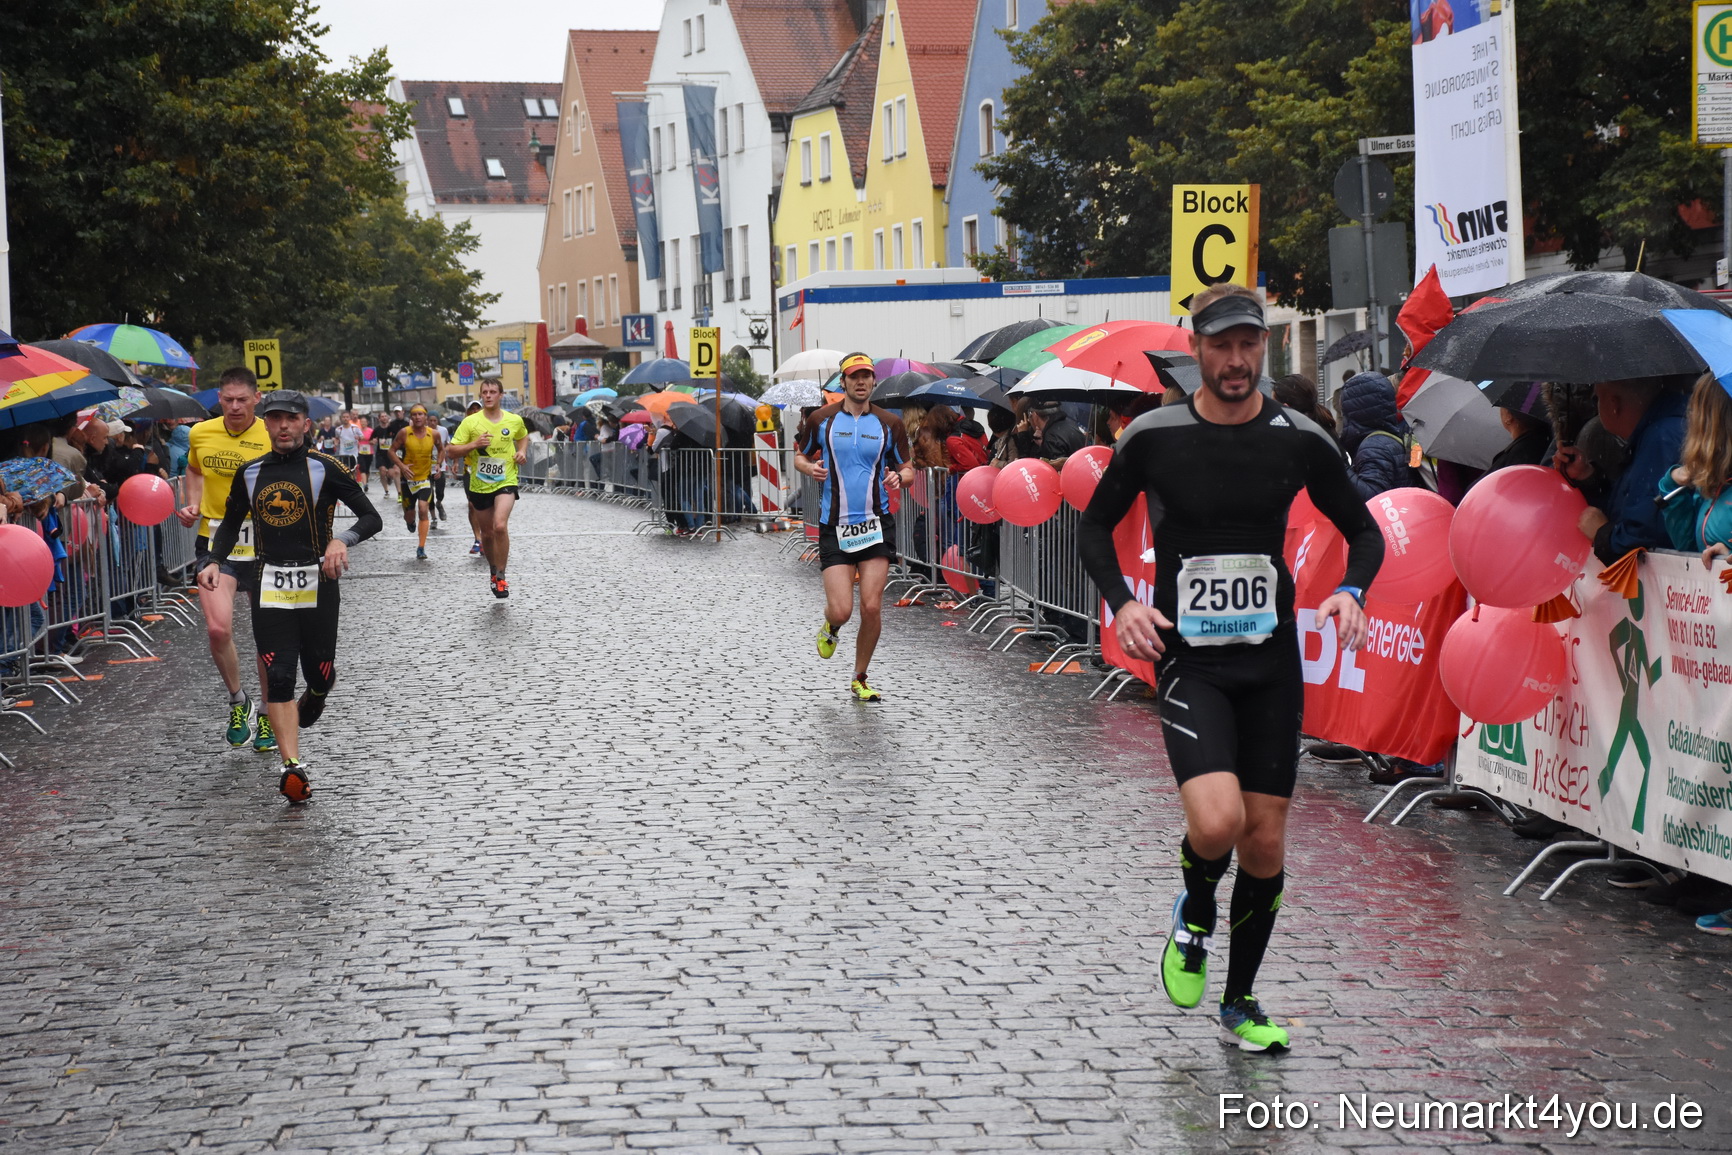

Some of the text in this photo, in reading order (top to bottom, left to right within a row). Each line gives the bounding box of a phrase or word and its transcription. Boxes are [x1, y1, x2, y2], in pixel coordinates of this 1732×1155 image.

[1371, 138, 1416, 151] Ulmer Gass
[1182, 190, 1249, 214] Block
[813, 208, 834, 232] HOTEL
[1192, 223, 1237, 288] C
[693, 328, 717, 338] Block
[248, 341, 276, 352] Block
[698, 342, 713, 367] D
[254, 355, 273, 380] D
[364, 379, 376, 387] TAXI
[258, 481, 304, 501] CONTINENTAL
[240, 527, 250, 544] 1
[841, 519, 878, 538] 2684
[846, 535, 876, 548] Sebastian
[273, 570, 308, 589] 618
[1189, 575, 1268, 612] 2506
[1665, 585, 1712, 615] Service-Line:
[1201, 620, 1257, 634] Christian
[1671, 652, 1732, 690] www.jura-gebaeu
[1668, 719, 1732, 774] Gebäudereinig
[1667, 766, 1732, 811] Hausmeisterd
[1663, 813, 1732, 861] Arbeitsbühne
